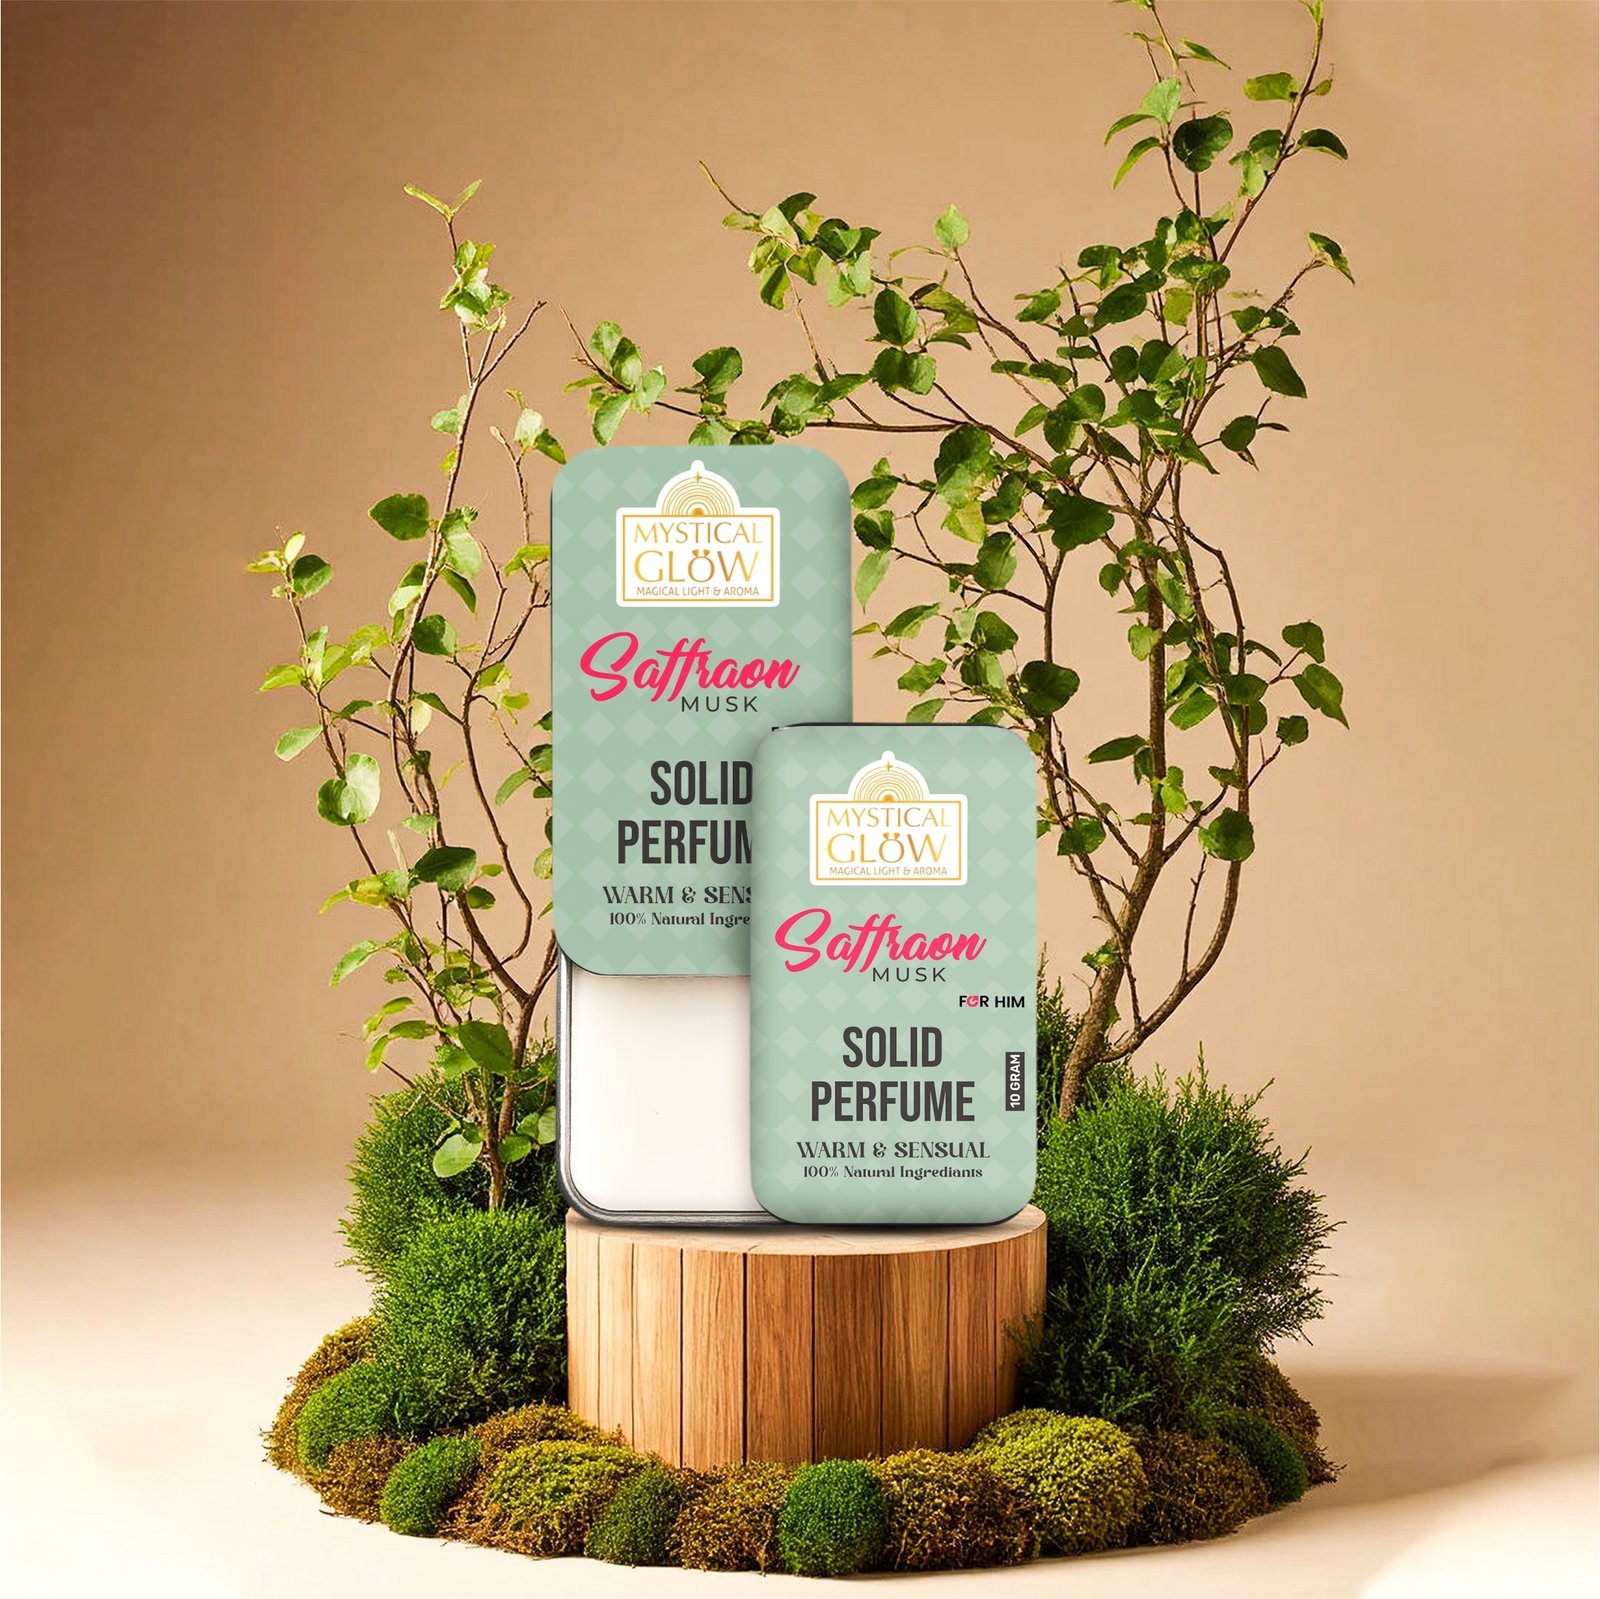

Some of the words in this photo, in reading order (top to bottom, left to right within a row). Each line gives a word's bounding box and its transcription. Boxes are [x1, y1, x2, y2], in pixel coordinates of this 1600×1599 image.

[634, 522, 763, 544] MYSTICAL
[637, 586, 680, 596] MAGICAL
[682, 586, 711, 596] LIGHT
[713, 586, 721, 596] &
[723, 586, 759, 596] AROMA
[580, 632, 800, 702] Saffraon
[681, 696, 758, 712] MUSK
[650, 760, 753, 806] SOLID
[827, 807, 952, 827] MYSTICAL
[829, 866, 871, 876] MAGICAL
[873, 866, 900, 876] LIGHT
[903, 866, 910, 876] &
[912, 866, 948, 876] AROMA
[602, 886, 674, 904] WARM
[682, 886, 696, 904] &
[610, 912, 647, 925] 100%
[651, 912, 705, 925] Natural
[775, 908, 987, 973] Saffraon
[872, 967, 946, 982] MUSK
[959, 995, 989, 1008] FOR
[995, 996, 1025, 1008] HIM
[843, 1026, 942, 1068] SOLID
[1010, 1054, 1021, 1091] GRAM
[811, 1081, 975, 1122] PERFUME
[1010, 1094, 1021, 1108] 10
[796, 1141, 865, 1158] WARM
[873, 1141, 887, 1158] &
[894, 1141, 991, 1158] SENSUAL
[803, 1166, 839, 1178] 100%
[844, 1166, 895, 1178] Natural
[900, 1166, 983, 1181] Ingrediants
